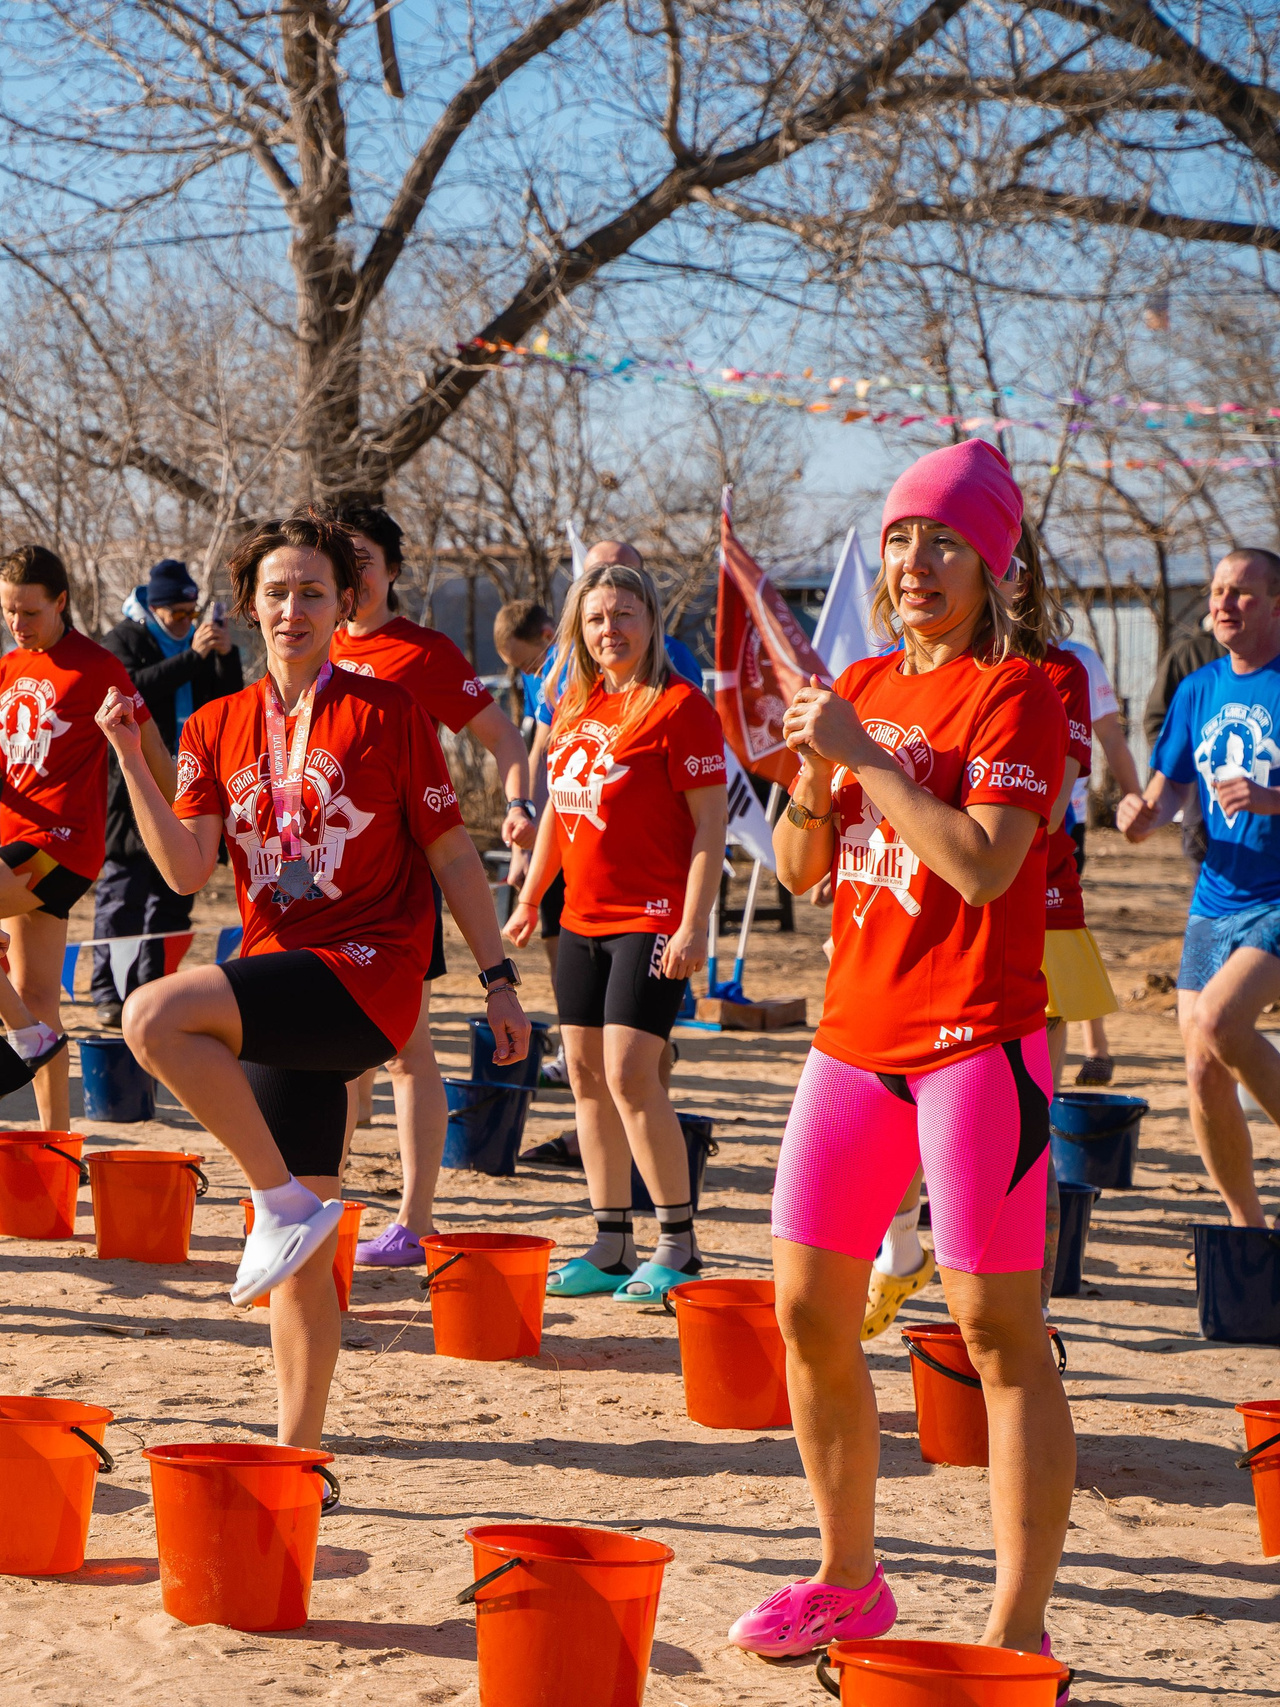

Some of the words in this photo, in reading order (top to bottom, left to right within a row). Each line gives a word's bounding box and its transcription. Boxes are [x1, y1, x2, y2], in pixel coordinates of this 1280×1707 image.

[867, 723, 900, 748] СЛАВА
[274, 749, 284, 775] МОРЖИ
[992, 761, 1035, 778] ПУТЬ
[231, 769, 256, 796] СИЛА
[988, 774, 1048, 796] ДОМОЙ
[646, 898, 669, 909] N1
[939, 1025, 974, 1042] N1
